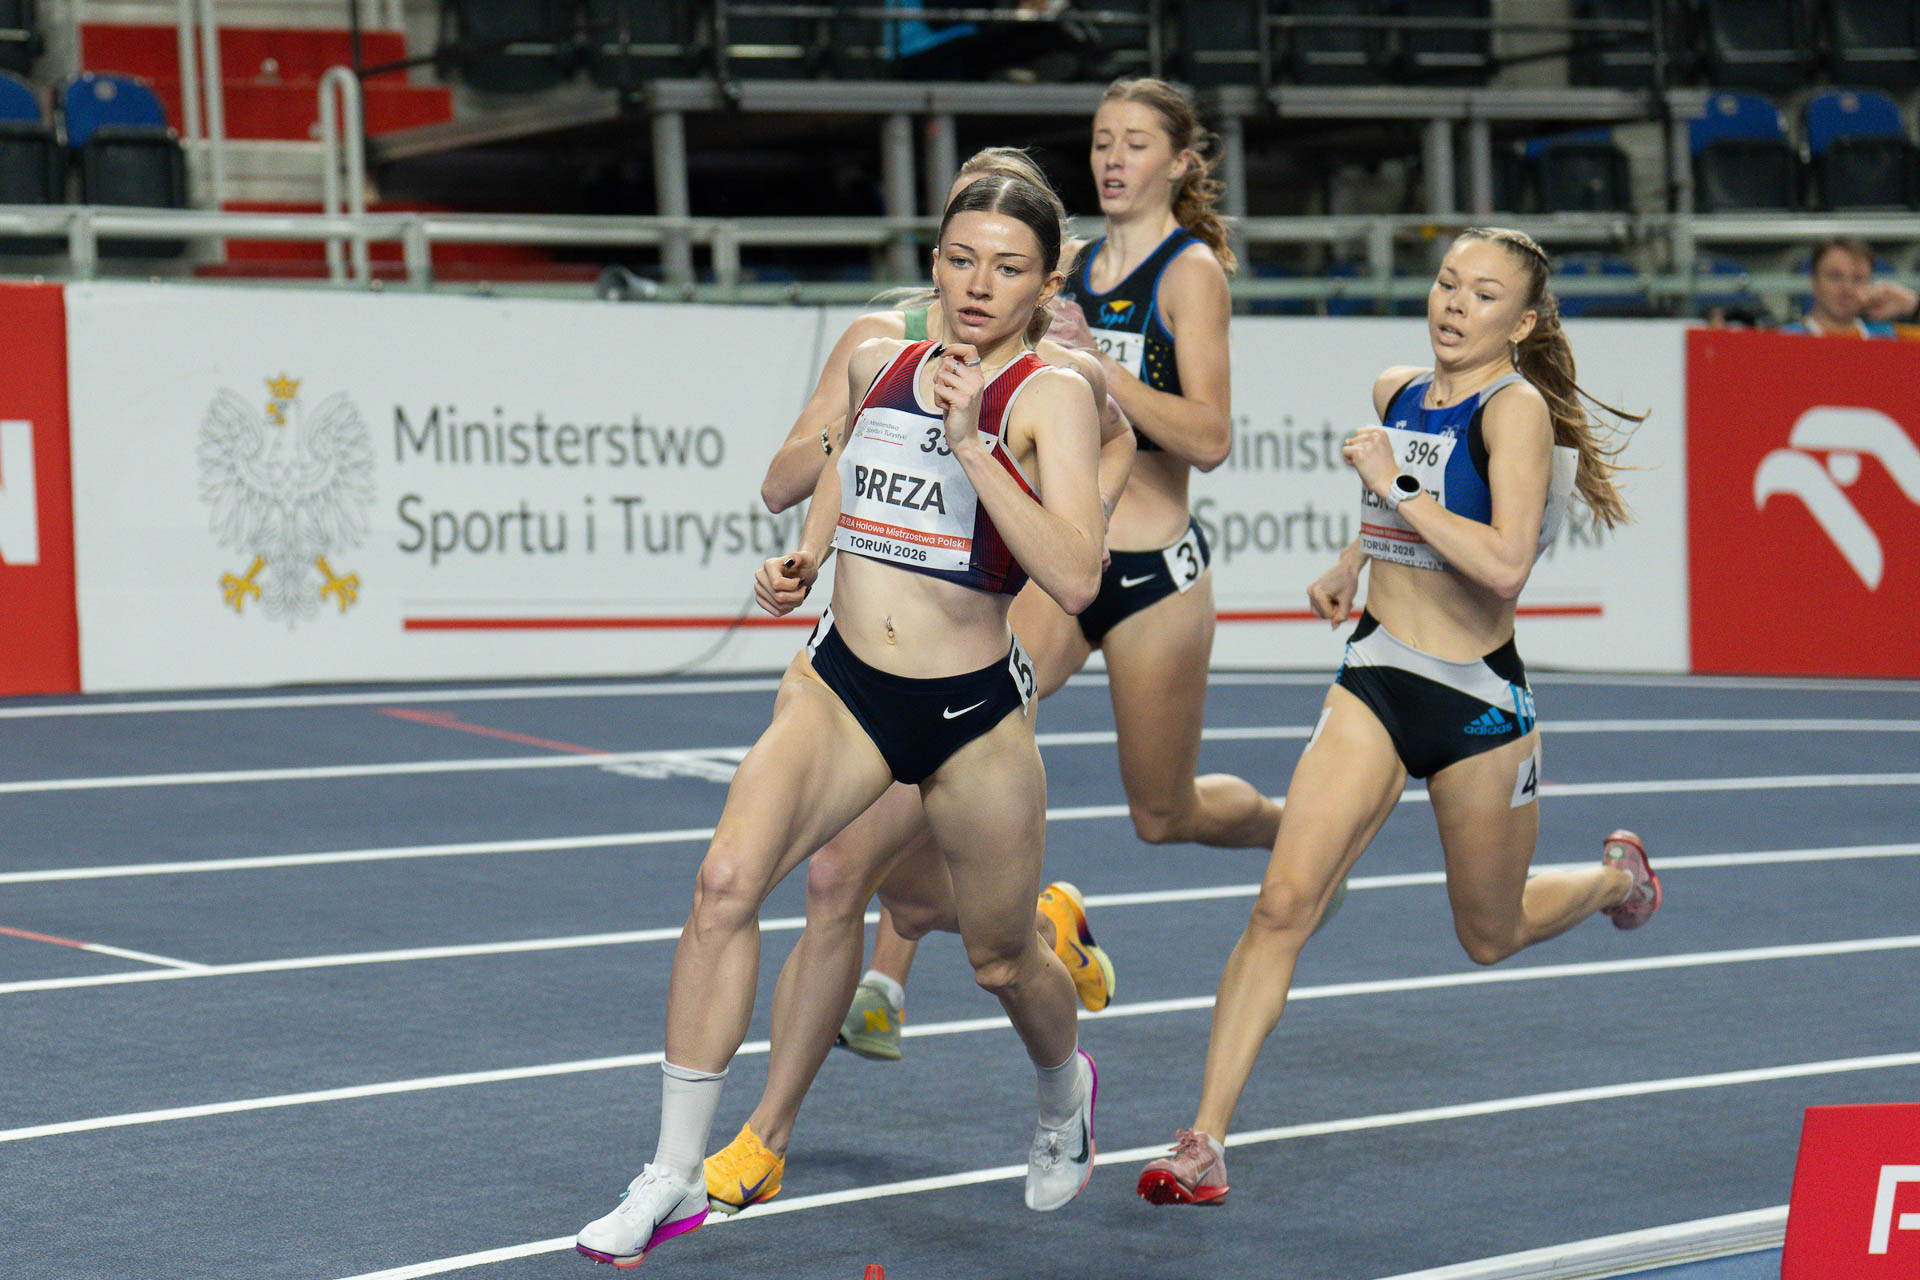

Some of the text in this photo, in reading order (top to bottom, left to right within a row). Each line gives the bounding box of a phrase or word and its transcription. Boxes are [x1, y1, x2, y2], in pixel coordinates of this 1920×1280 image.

[393, 404, 725, 468] Ministerstwo
[1405, 440, 1441, 467] 396
[855, 464, 947, 515] BREZA
[397, 494, 804, 567] Sportu i Turysty
[850, 535, 927, 562] TORUŃ 2026
[855, 520, 885, 534] Halowe
[885, 527, 936, 544] Mistrzostwa
[937, 537, 967, 549] Polski
[1193, 497, 1349, 565] Sportu
[1392, 544, 1416, 557] 2026
[1176, 542, 1199, 581] 3
[1013, 646, 1033, 699] 5
[1464, 721, 1513, 736] adidas
[1521, 755, 1538, 796] 4
